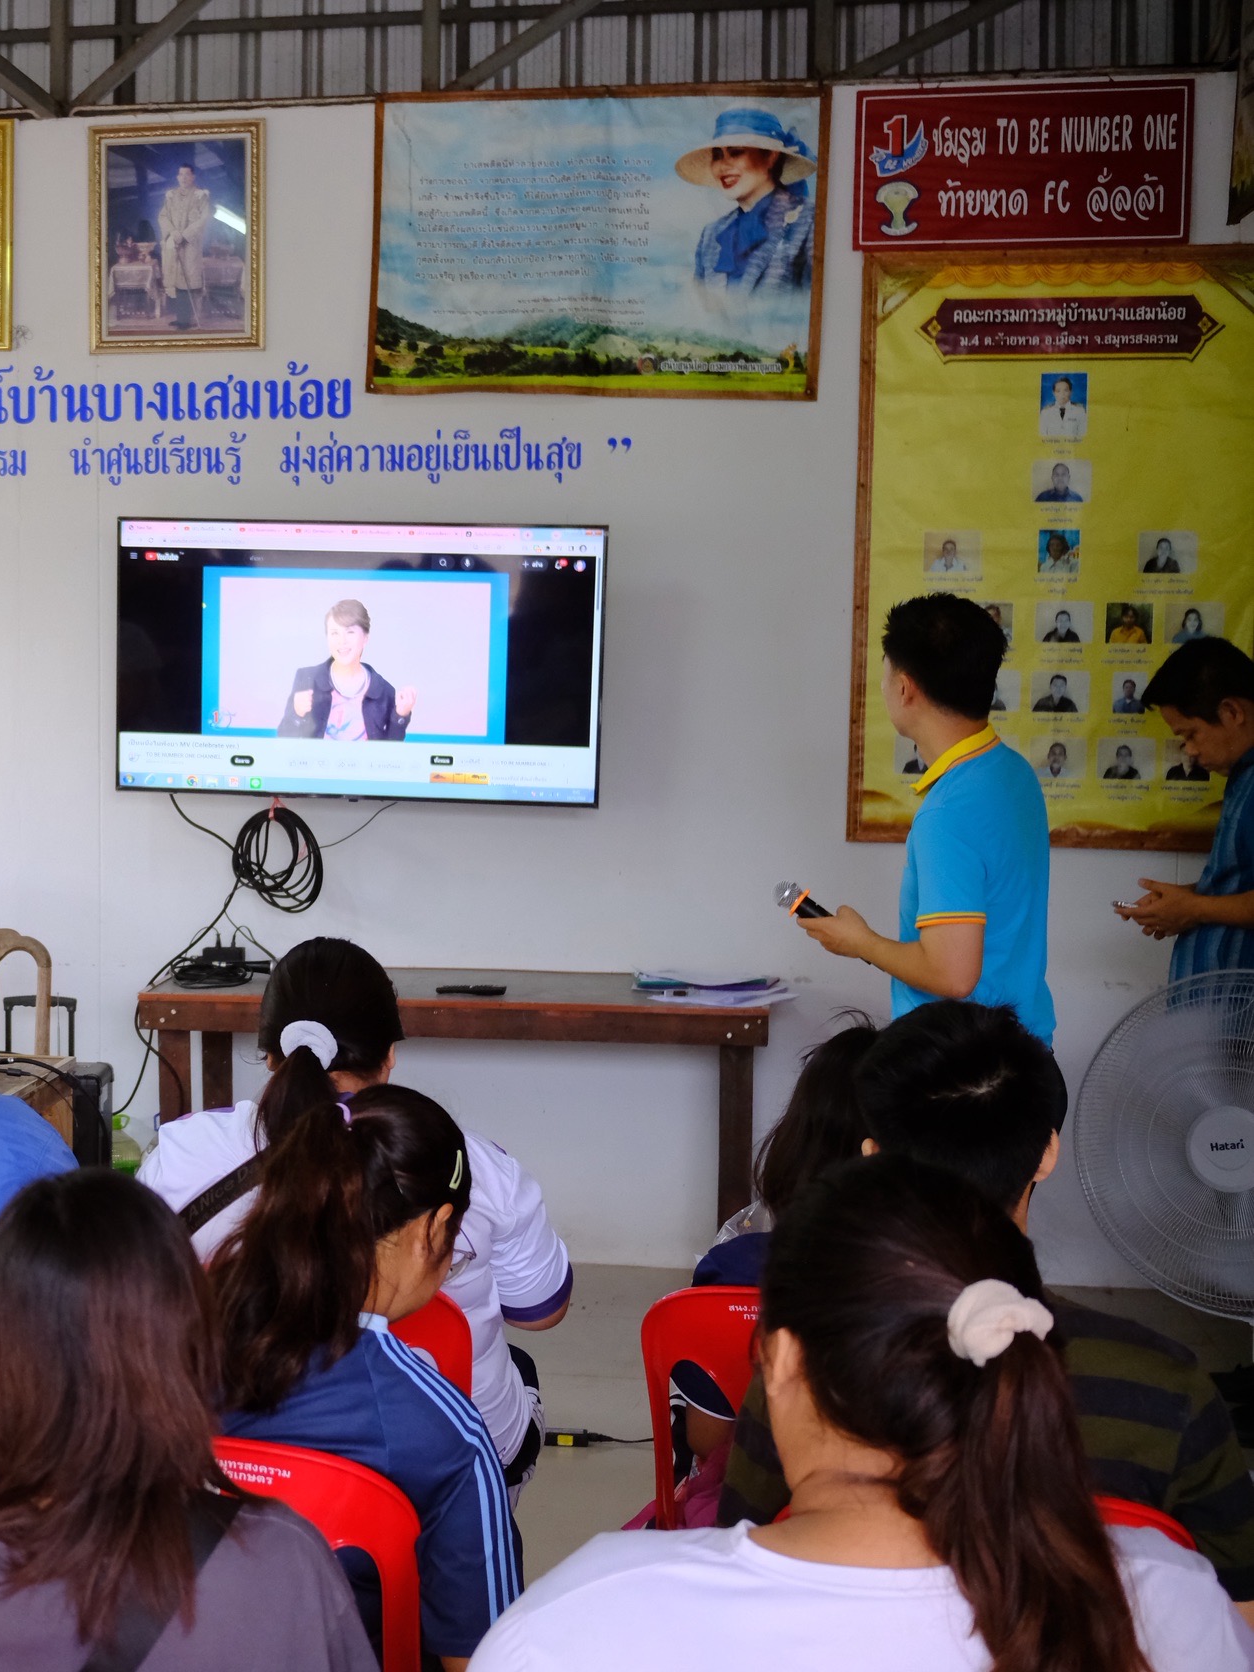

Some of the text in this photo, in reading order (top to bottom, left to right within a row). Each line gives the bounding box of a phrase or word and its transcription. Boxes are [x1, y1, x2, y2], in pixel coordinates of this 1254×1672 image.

[933, 116, 986, 167] ชมรม
[997, 118, 1019, 155] TO
[1029, 117, 1050, 154] BE
[1061, 115, 1133, 153] NUMBER
[1144, 113, 1178, 150] ONE
[938, 179, 1027, 219] ท้ายหาด
[1044, 180, 1070, 214] FC
[953, 302, 1186, 328] คณะกรรมการหมู่บ้านบางแสมน้อย
[70, 431, 247, 485] นำศูนย์เรียนรู้
[279, 426, 583, 486] มุ่งสู่ความอยู่เย็นเป็นสุข
[1210, 1138, 1245, 1151] Hatari
